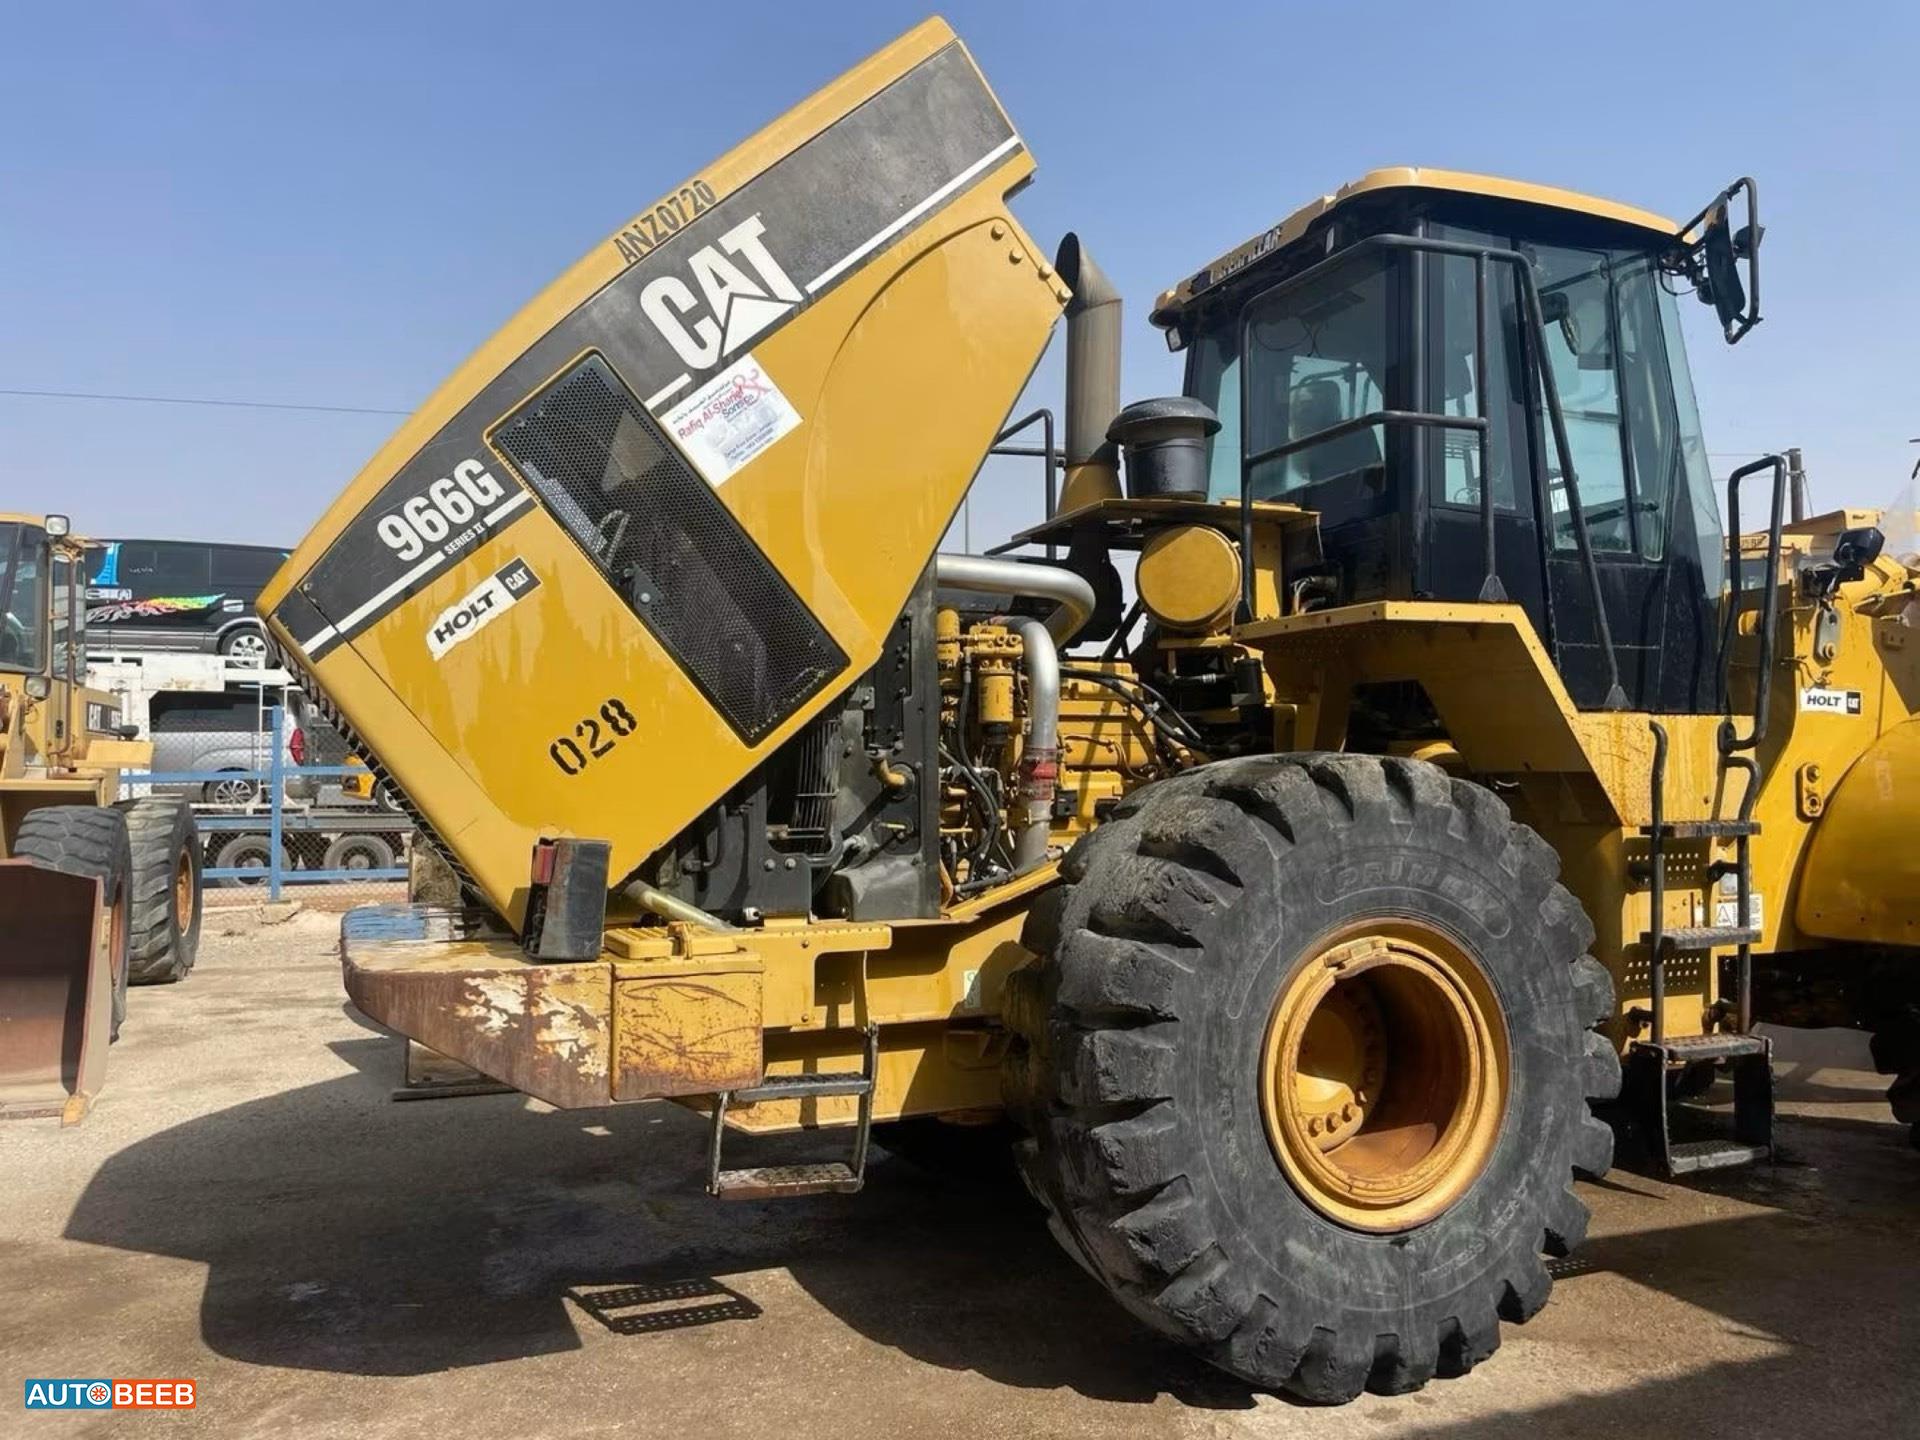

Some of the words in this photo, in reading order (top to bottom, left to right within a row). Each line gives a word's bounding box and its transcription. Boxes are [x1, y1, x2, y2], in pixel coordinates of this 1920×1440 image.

[613, 179, 717, 264] ANZ0720
[640, 212, 804, 369] CAT
[377, 458, 505, 561] 966G
[444, 529, 476, 555] SERIES
[473, 522, 486, 535] II
[434, 589, 494, 643] HOLT
[505, 567, 529, 590] CAT
[550, 698, 637, 775] 028
[1807, 695, 1842, 706] HOLT
